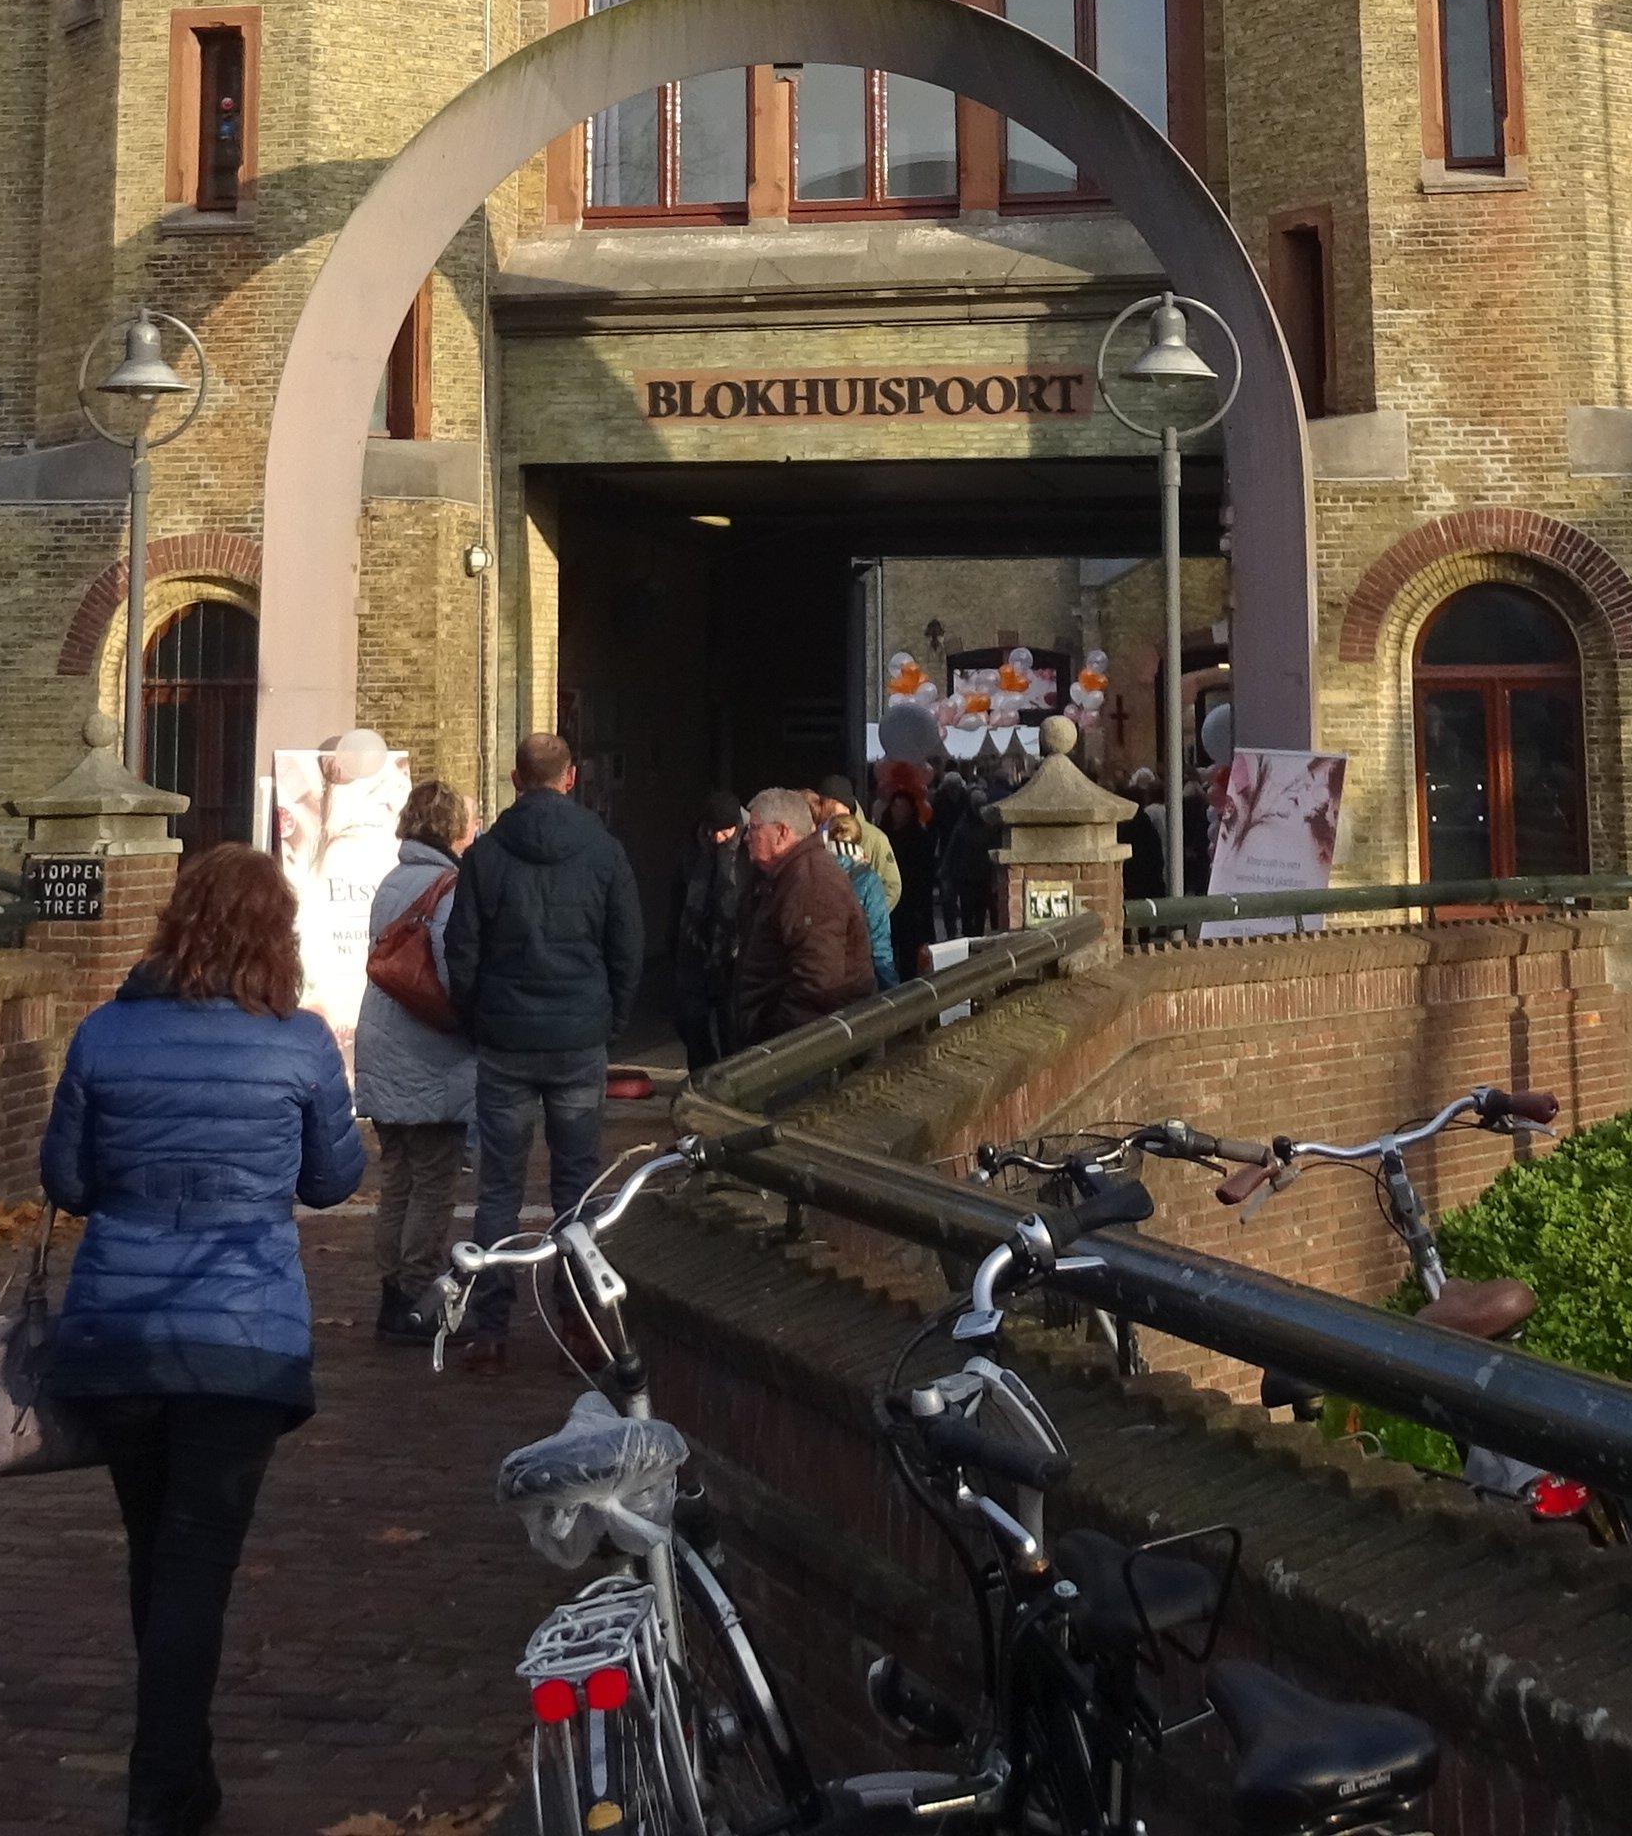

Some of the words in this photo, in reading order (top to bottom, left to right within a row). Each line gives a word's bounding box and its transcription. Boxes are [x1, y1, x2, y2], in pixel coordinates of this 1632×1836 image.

[646, 375, 1084, 419] BLOKHUISPOORT
[44, 882, 87, 897] VOOR
[33, 900, 99, 914] STREEP
